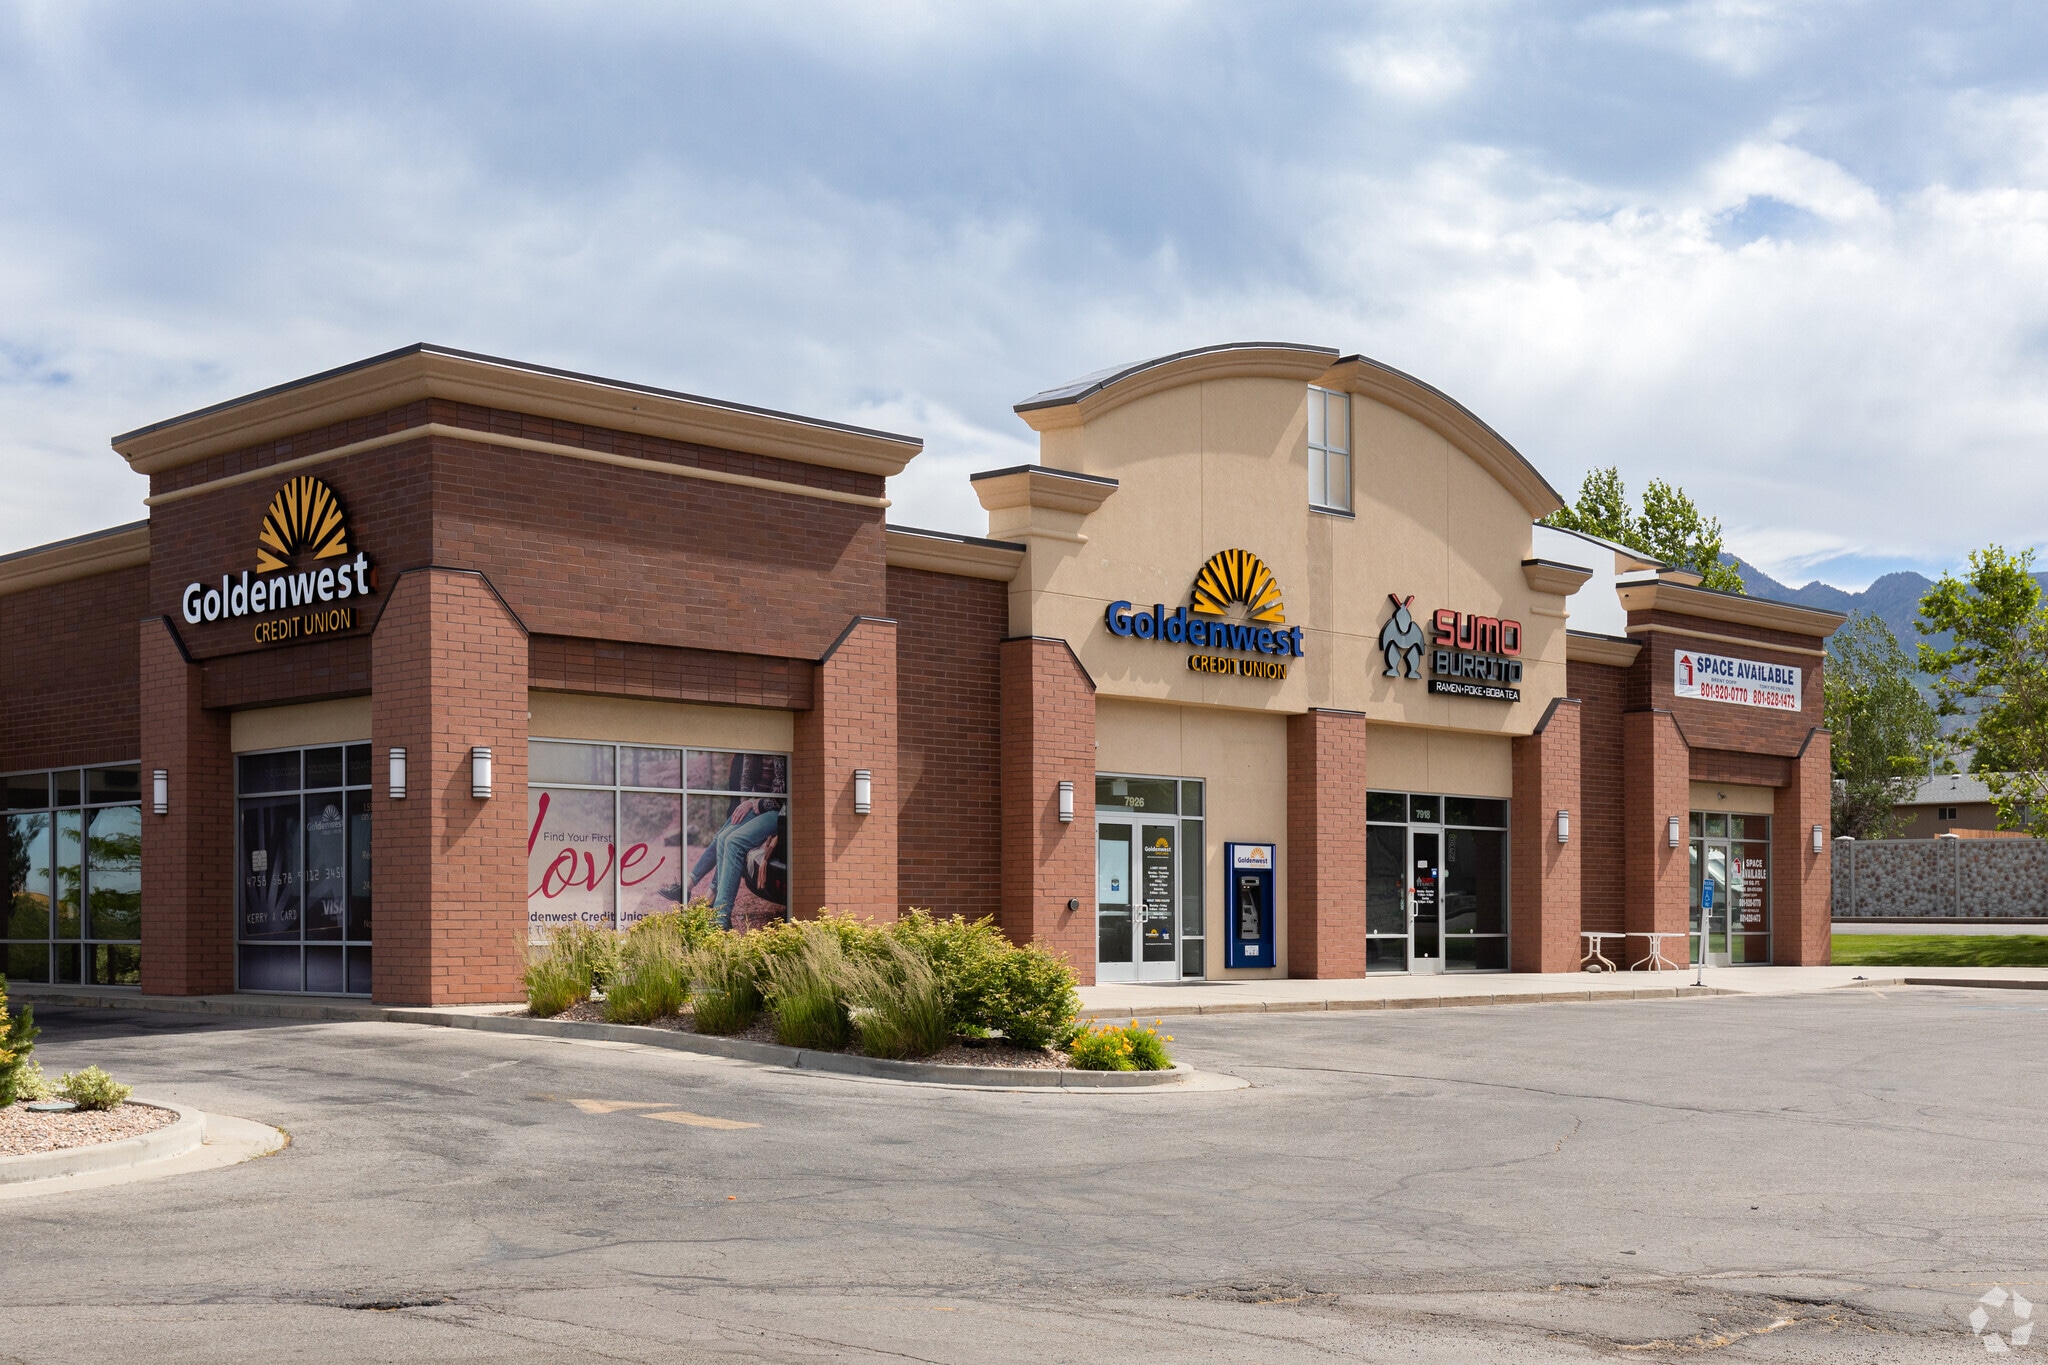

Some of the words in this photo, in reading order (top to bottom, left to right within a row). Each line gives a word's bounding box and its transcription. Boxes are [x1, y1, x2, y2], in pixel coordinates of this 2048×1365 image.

[182, 551, 369, 625] Goldenwest
[253, 616, 300, 643] CREDIT
[304, 607, 351, 635] UNION
[1105, 600, 1305, 657] Goldenwest
[1433, 608, 1522, 656] SUMO
[1190, 654, 1239, 674] CREDIT
[1242, 660, 1287, 680] UNION
[1434, 650, 1523, 683] BURRITO
[1697, 655, 1735, 677] SPACE
[1737, 660, 1794, 686] AVAILABLE
[1505, 690, 1519, 700] TEA
[1700, 682, 1748, 703] 801-920-0770
[1752, 689, 1795, 709] 801-628-1473
[1124, 796, 1145, 807] 7926
[1416, 809, 1431, 819] 7918
[543, 831, 565, 842] Find
[567, 832, 589, 842] Your
[591, 833, 613, 843] First
[1746, 859, 1762, 867] SPACE
[247, 912, 268, 924] KERRY
[280, 909, 297, 921] CARD
[580, 911, 615, 921] Credit
